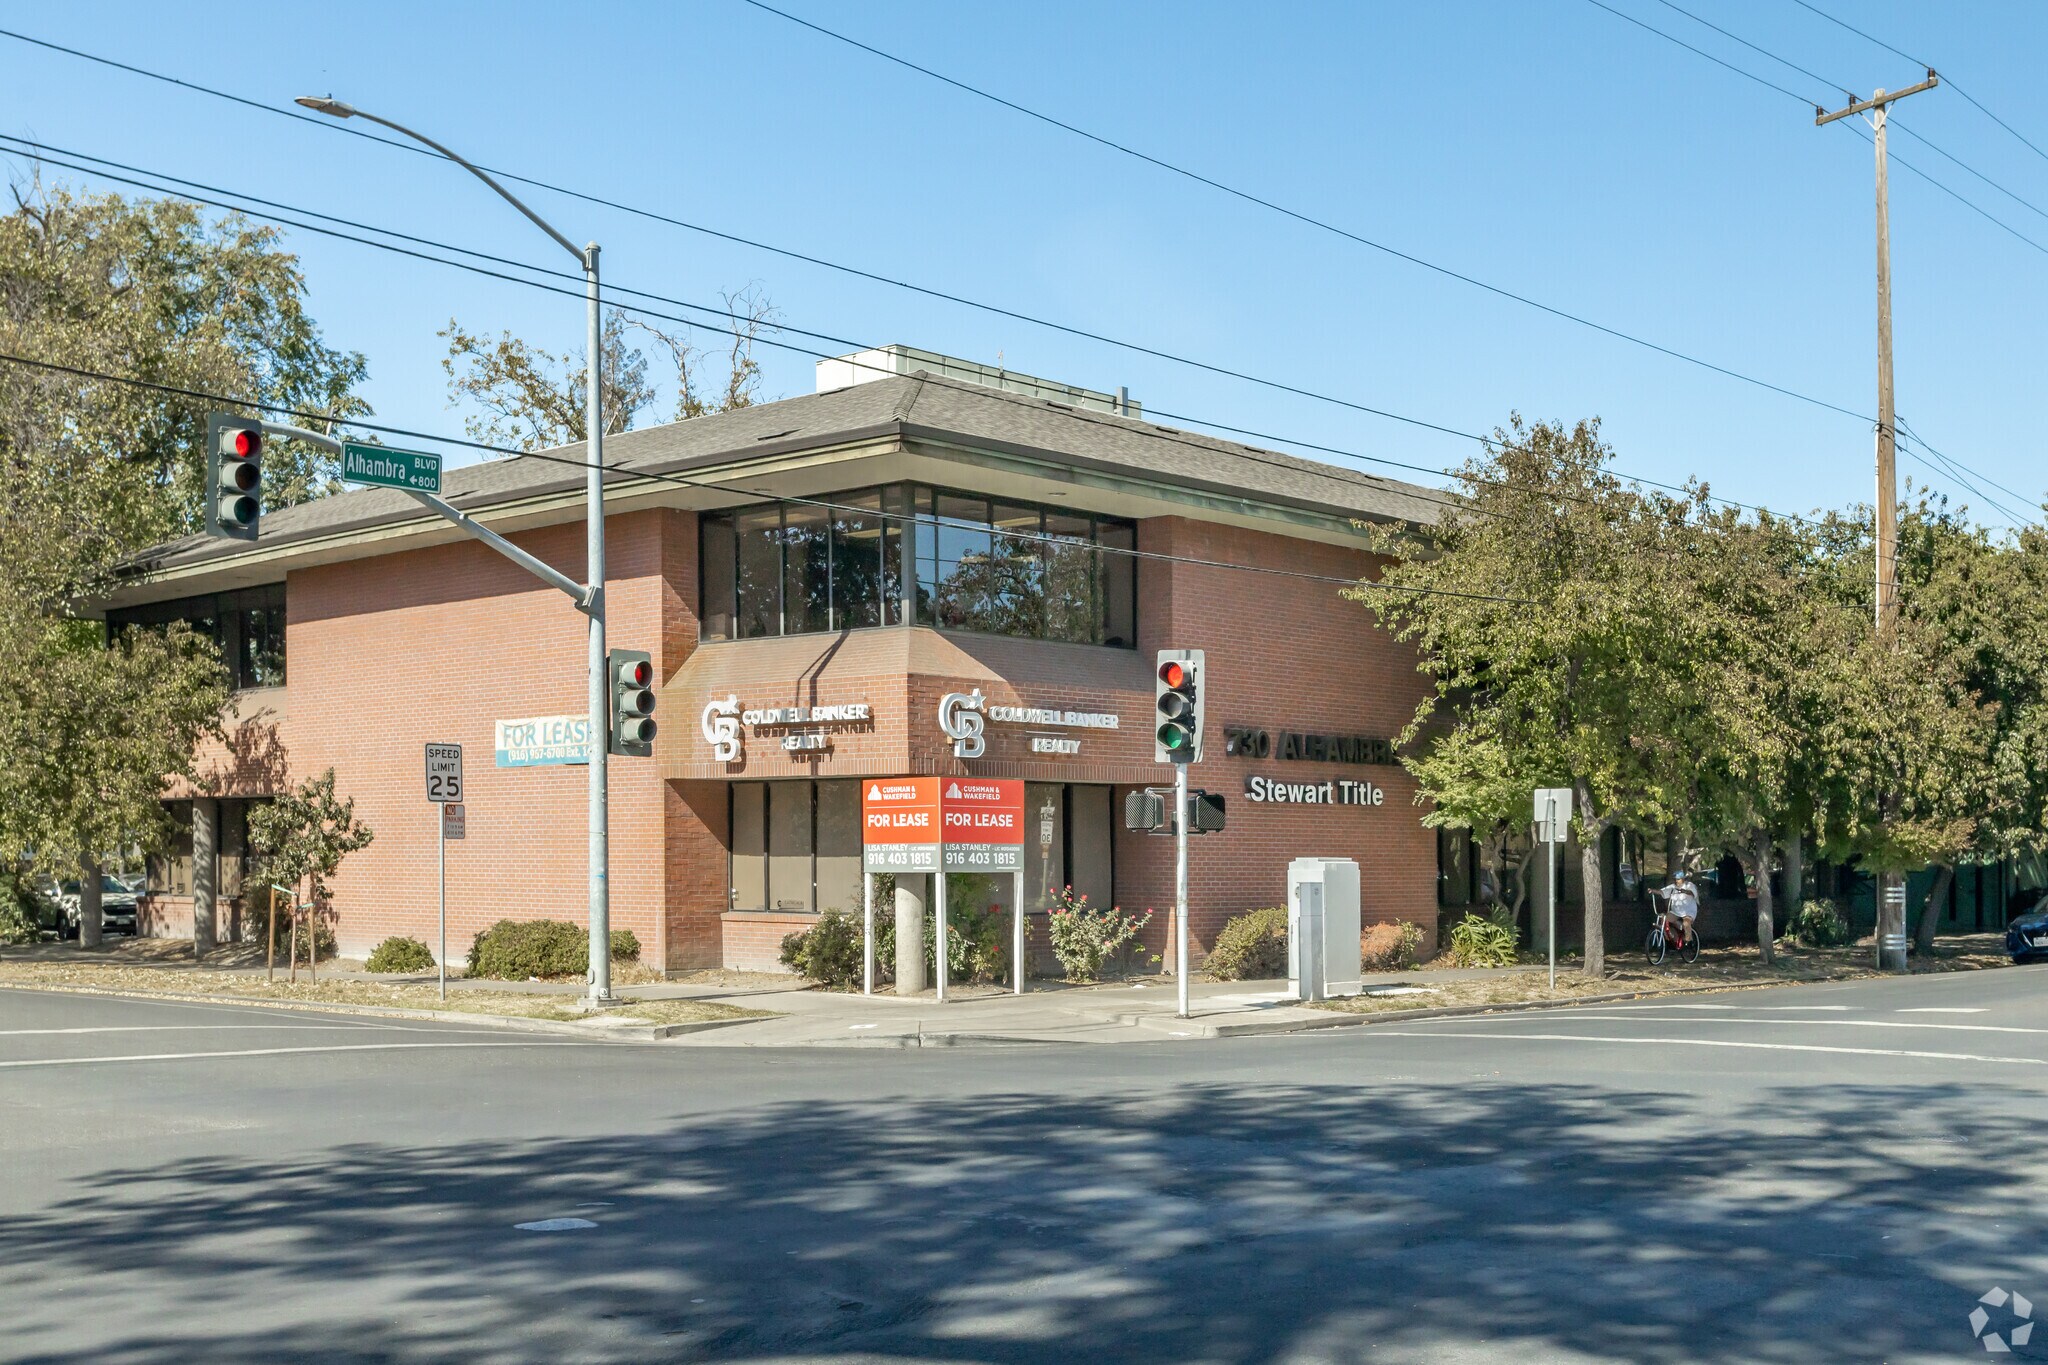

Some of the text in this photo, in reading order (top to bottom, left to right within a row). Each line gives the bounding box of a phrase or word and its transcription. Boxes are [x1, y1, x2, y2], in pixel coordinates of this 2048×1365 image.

[347, 452, 405, 480] Alhambra
[414, 458, 436, 470] BLVD
[418, 476, 436, 488] 800
[812, 704, 870, 721] BANKER
[988, 706, 1119, 729] COLDWELL BANKER
[503, 724, 537, 747] FOR
[781, 735, 825, 750] REALTY
[1224, 726, 1270, 758] 730
[428, 748, 460, 759] SPEED
[1031, 738, 1081, 754] REALTY
[508, 750, 528, 763] (916)
[432, 762, 456, 772] LIMIT
[430, 776, 460, 796] 25
[1249, 776, 1384, 806] Stewart Title
[868, 813, 929, 828] FOR LEASE
[945, 813, 1014, 827] FOR LEASE
[868, 852, 932, 864] 916 403 1815
[946, 852, 1016, 864] 916 403 1815
